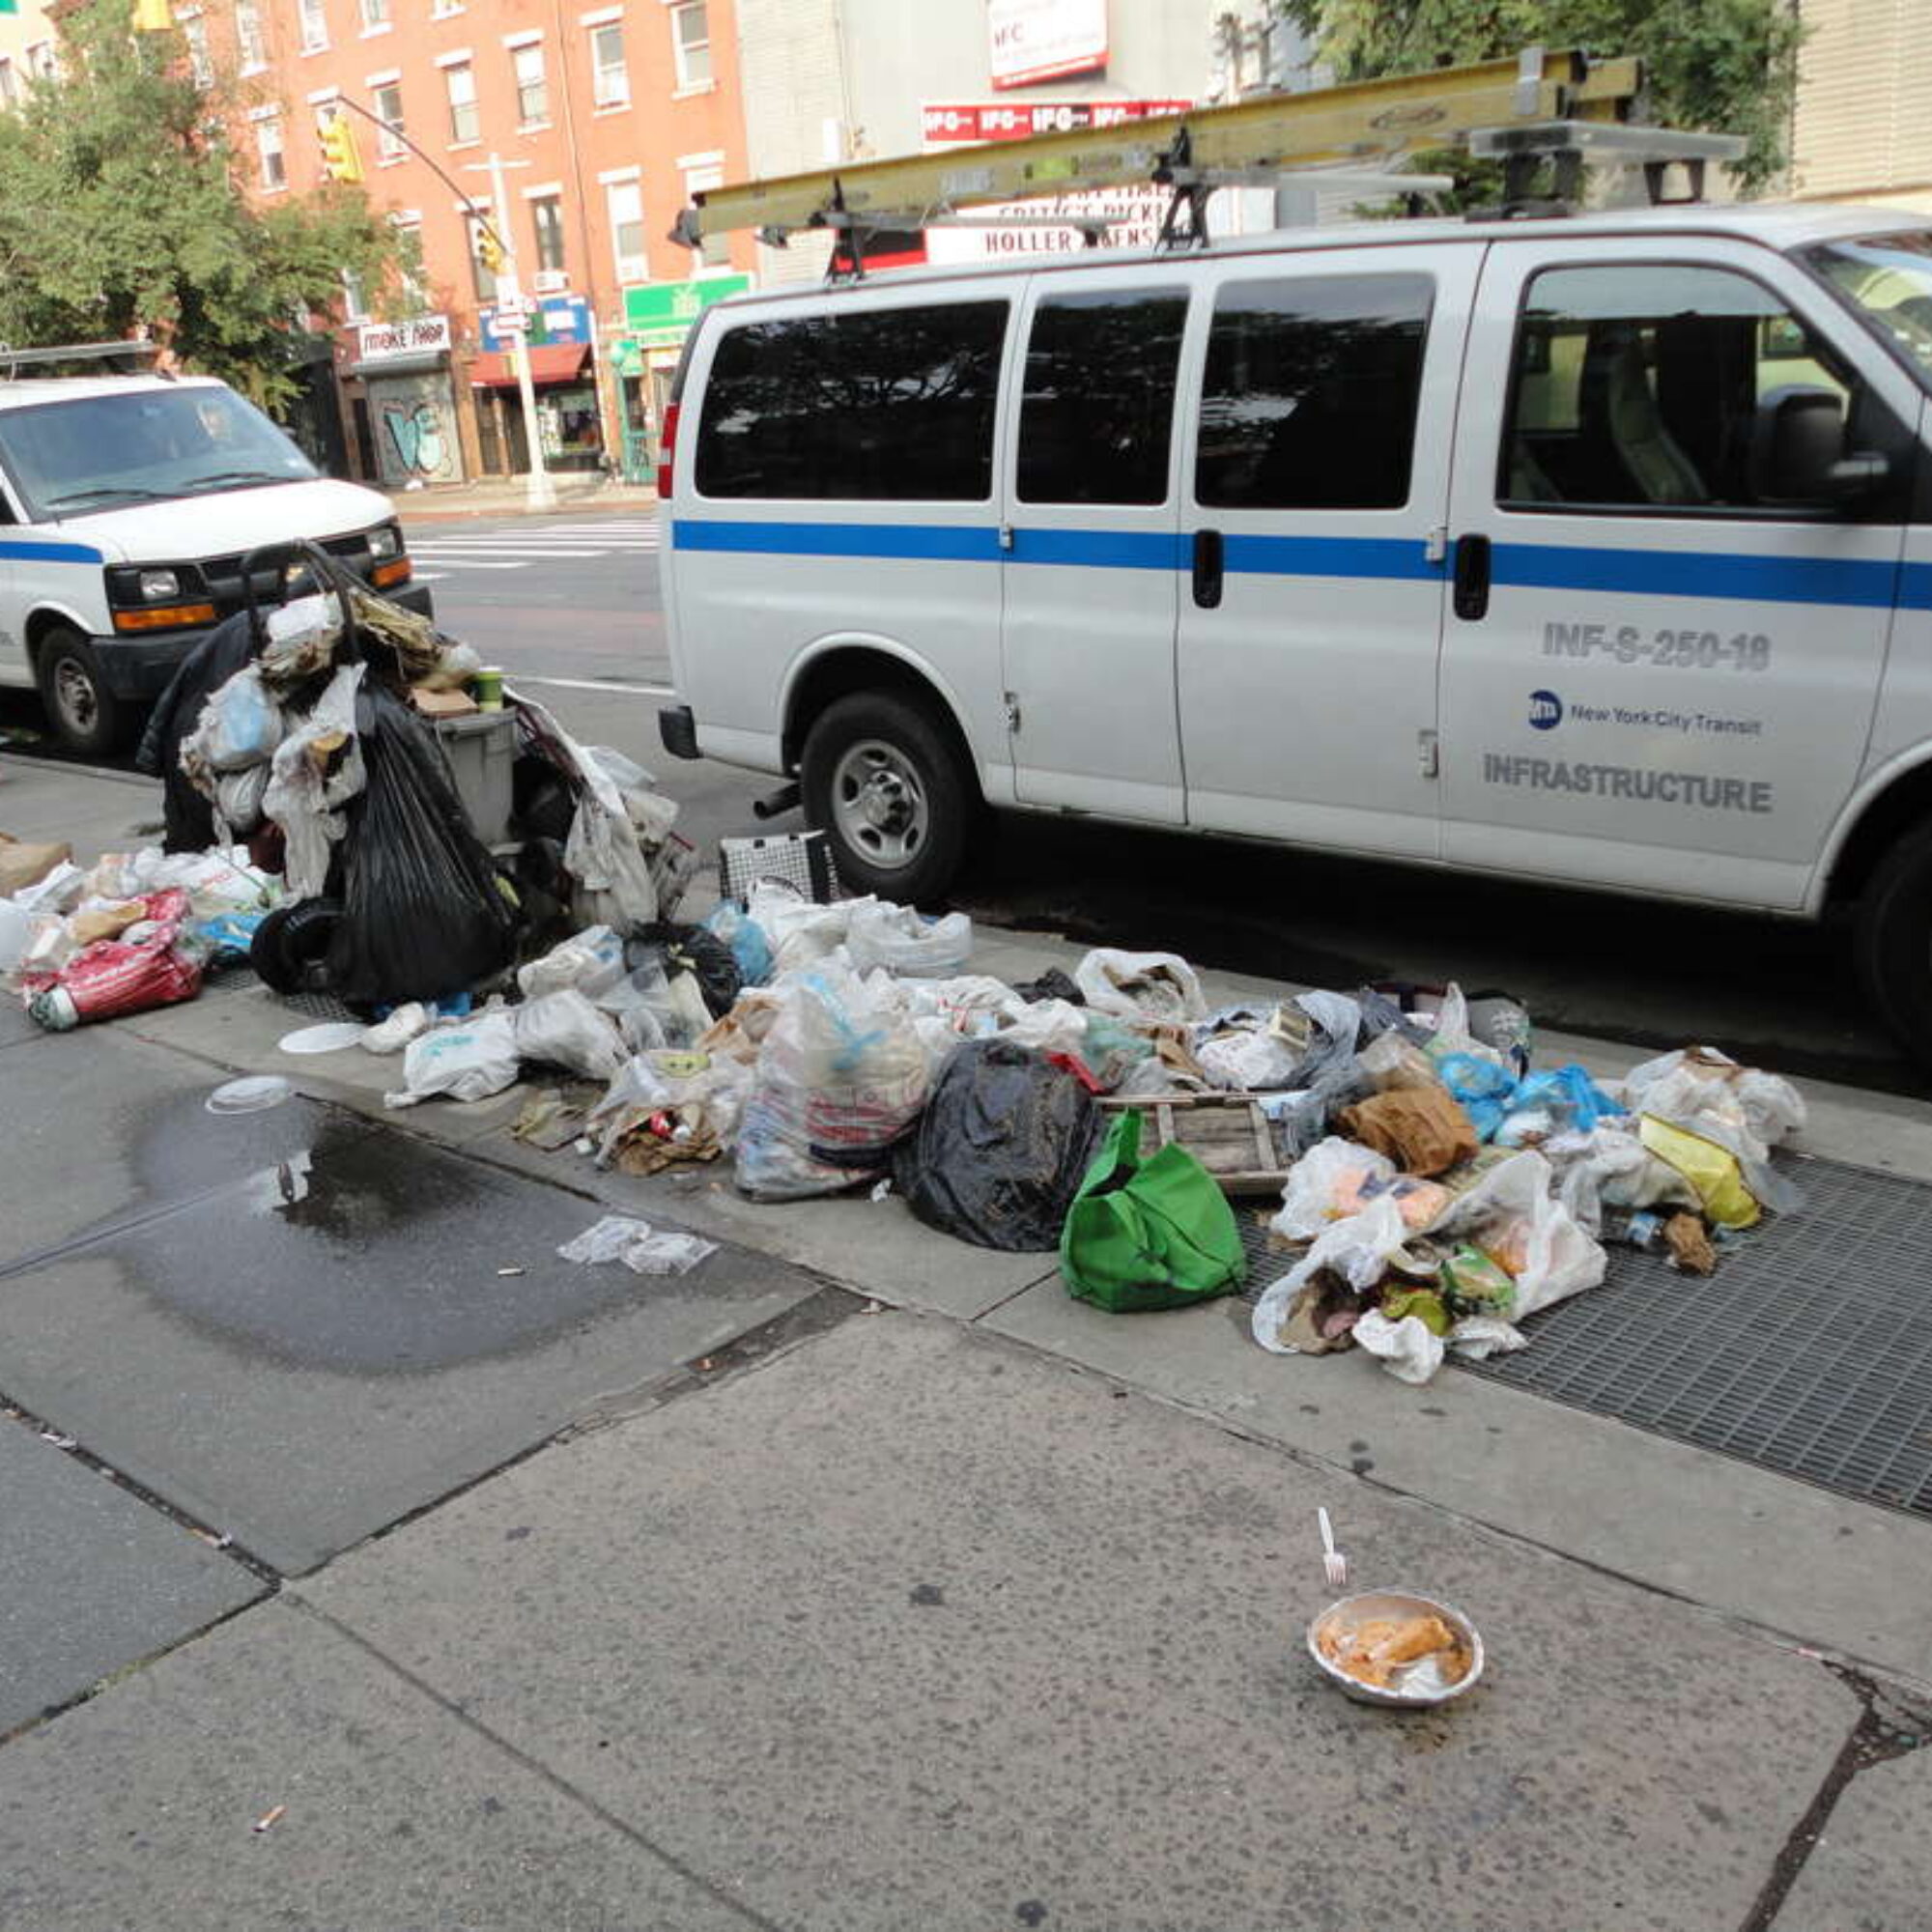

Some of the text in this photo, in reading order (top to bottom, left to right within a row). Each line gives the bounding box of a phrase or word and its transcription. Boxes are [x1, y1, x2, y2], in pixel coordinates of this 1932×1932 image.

[984, 229, 1072, 253] HOLLER
[1571, 704, 1610, 722] New
[1612, 707, 1651, 724] York
[1654, 709, 1691, 734] City
[1696, 714, 1763, 737] Transit
[1483, 753, 1775, 814] INFRASTRUCTURE
